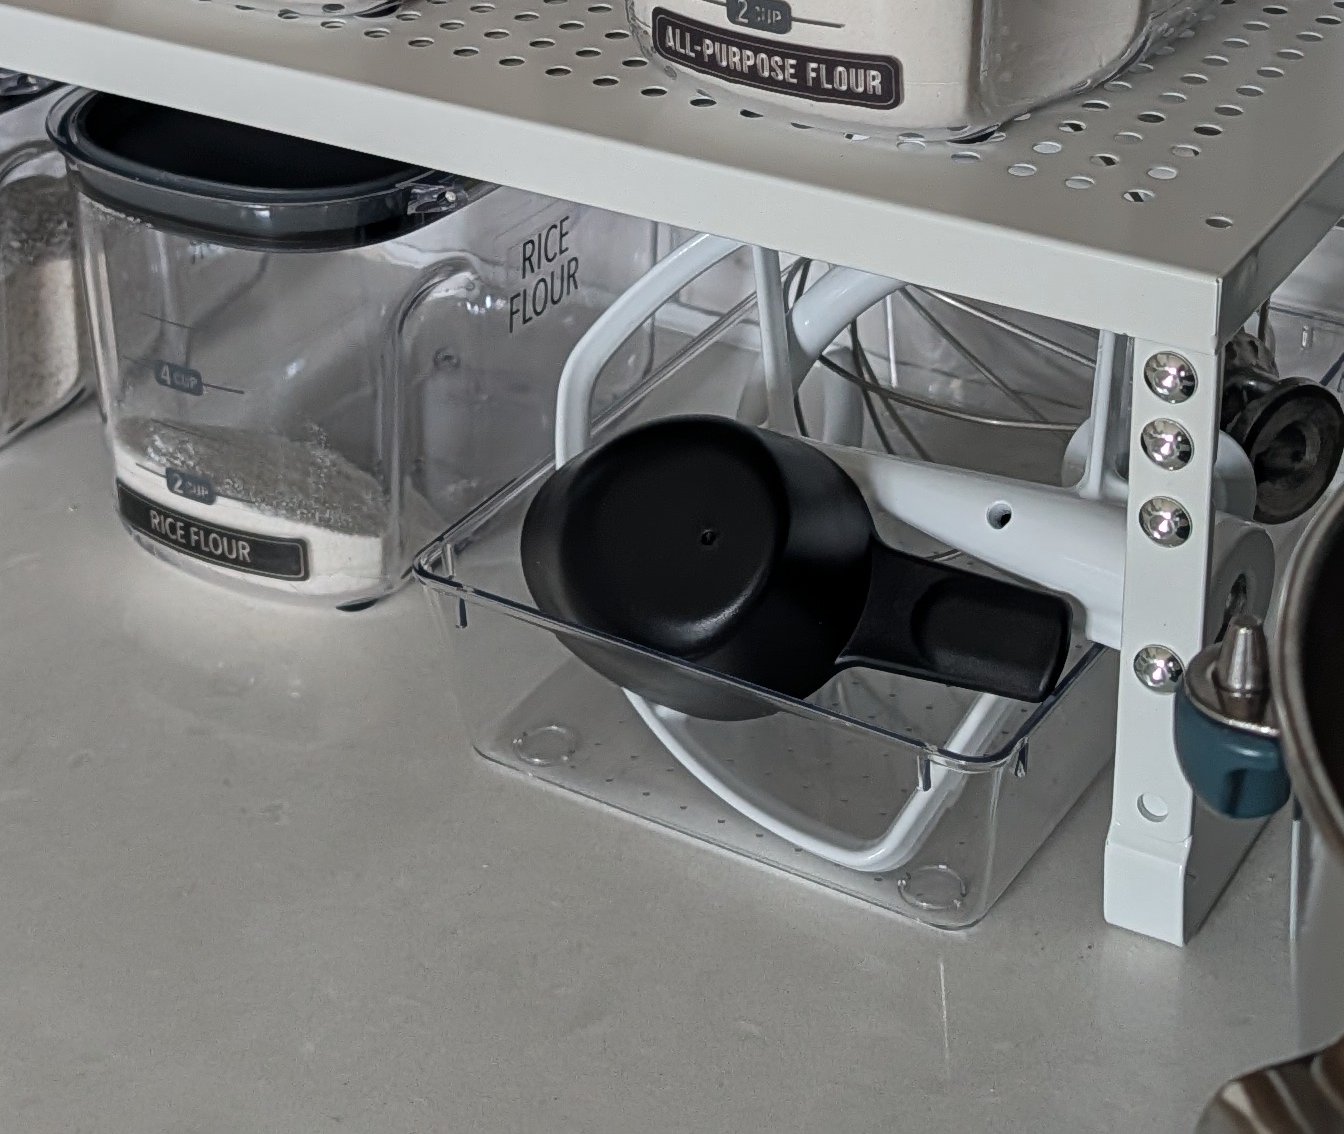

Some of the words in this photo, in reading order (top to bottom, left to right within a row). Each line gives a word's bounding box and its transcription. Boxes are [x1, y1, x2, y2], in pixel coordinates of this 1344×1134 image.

[665, 26, 798, 84] ALL-PURPOSE
[806, 63, 882, 95] FLOUR
[522, 216, 569, 279] RICE
[509, 257, 579, 333] FLOUR
[150, 510, 186, 543] RICE
[190, 527, 253, 563] FLOUR
